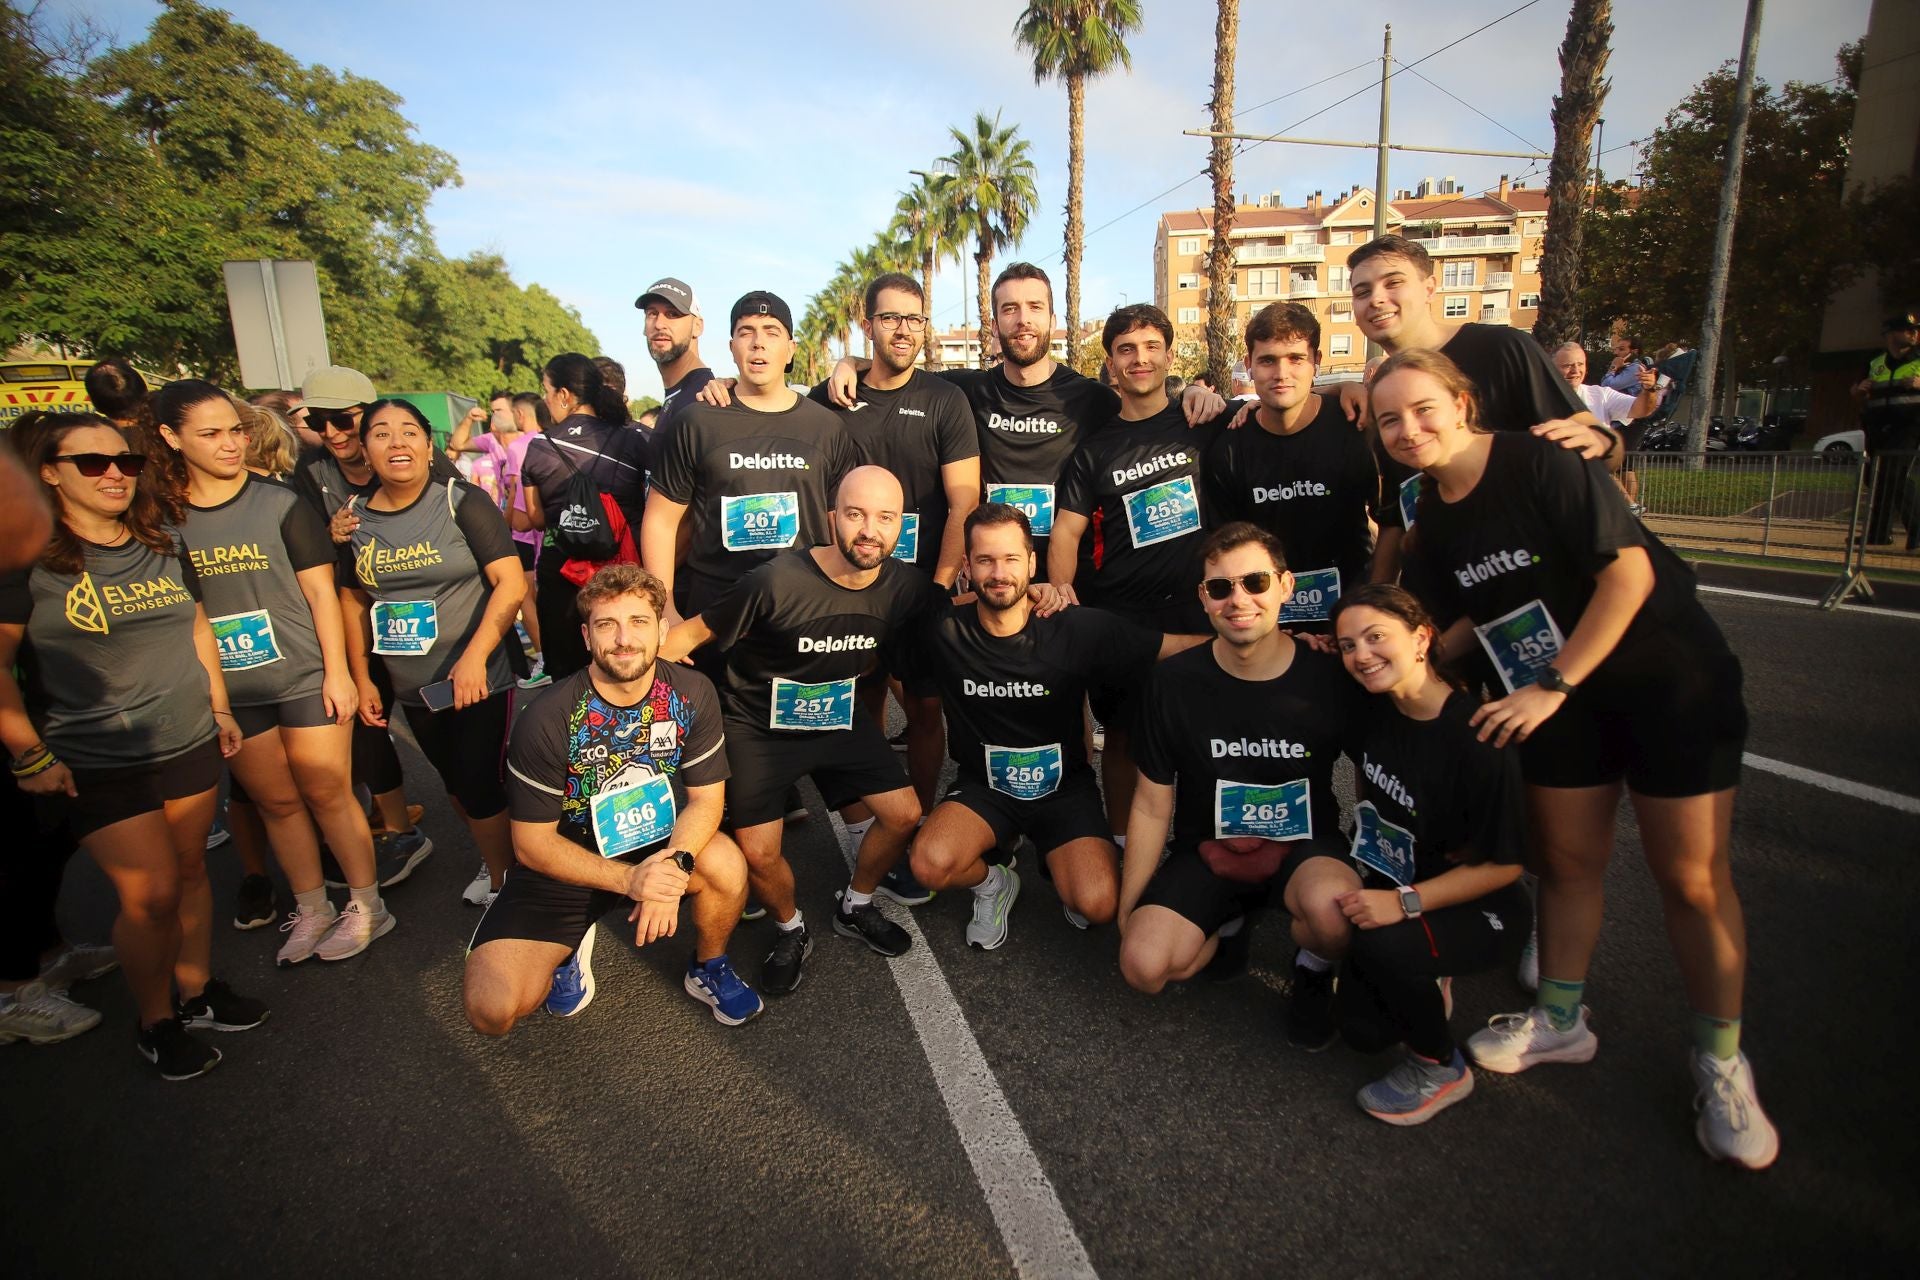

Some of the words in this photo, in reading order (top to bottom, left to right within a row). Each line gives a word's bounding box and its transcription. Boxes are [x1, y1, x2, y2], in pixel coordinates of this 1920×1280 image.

[988, 413, 1062, 433] Deloitte.
[729, 453, 810, 470] Deloitte.
[1112, 451, 1193, 486] Deloitte.
[1252, 480, 1331, 503] Deloitte.
[743, 511, 781, 528] 267
[1005, 502, 1037, 518] 50
[1145, 498, 1182, 522] 253
[376, 541, 439, 564] ELRAAL
[376, 554, 443, 574] CONSERVAS
[1454, 549, 1541, 587] eloitte.
[102, 576, 183, 604] ELRAAL
[111, 592, 192, 615] CONSERVAS
[387, 617, 420, 634] 207
[798, 634, 878, 653] Deloitte.
[1510, 628, 1557, 662] 258
[963, 679, 1050, 698] Deloitte.
[794, 697, 835, 713] 257
[650, 736, 673, 749] AXA
[1210, 738, 1311, 758] Deloitte.
[1006, 766, 1045, 782] 256
[614, 803, 657, 832] 266
[1242, 803, 1289, 821] 265
